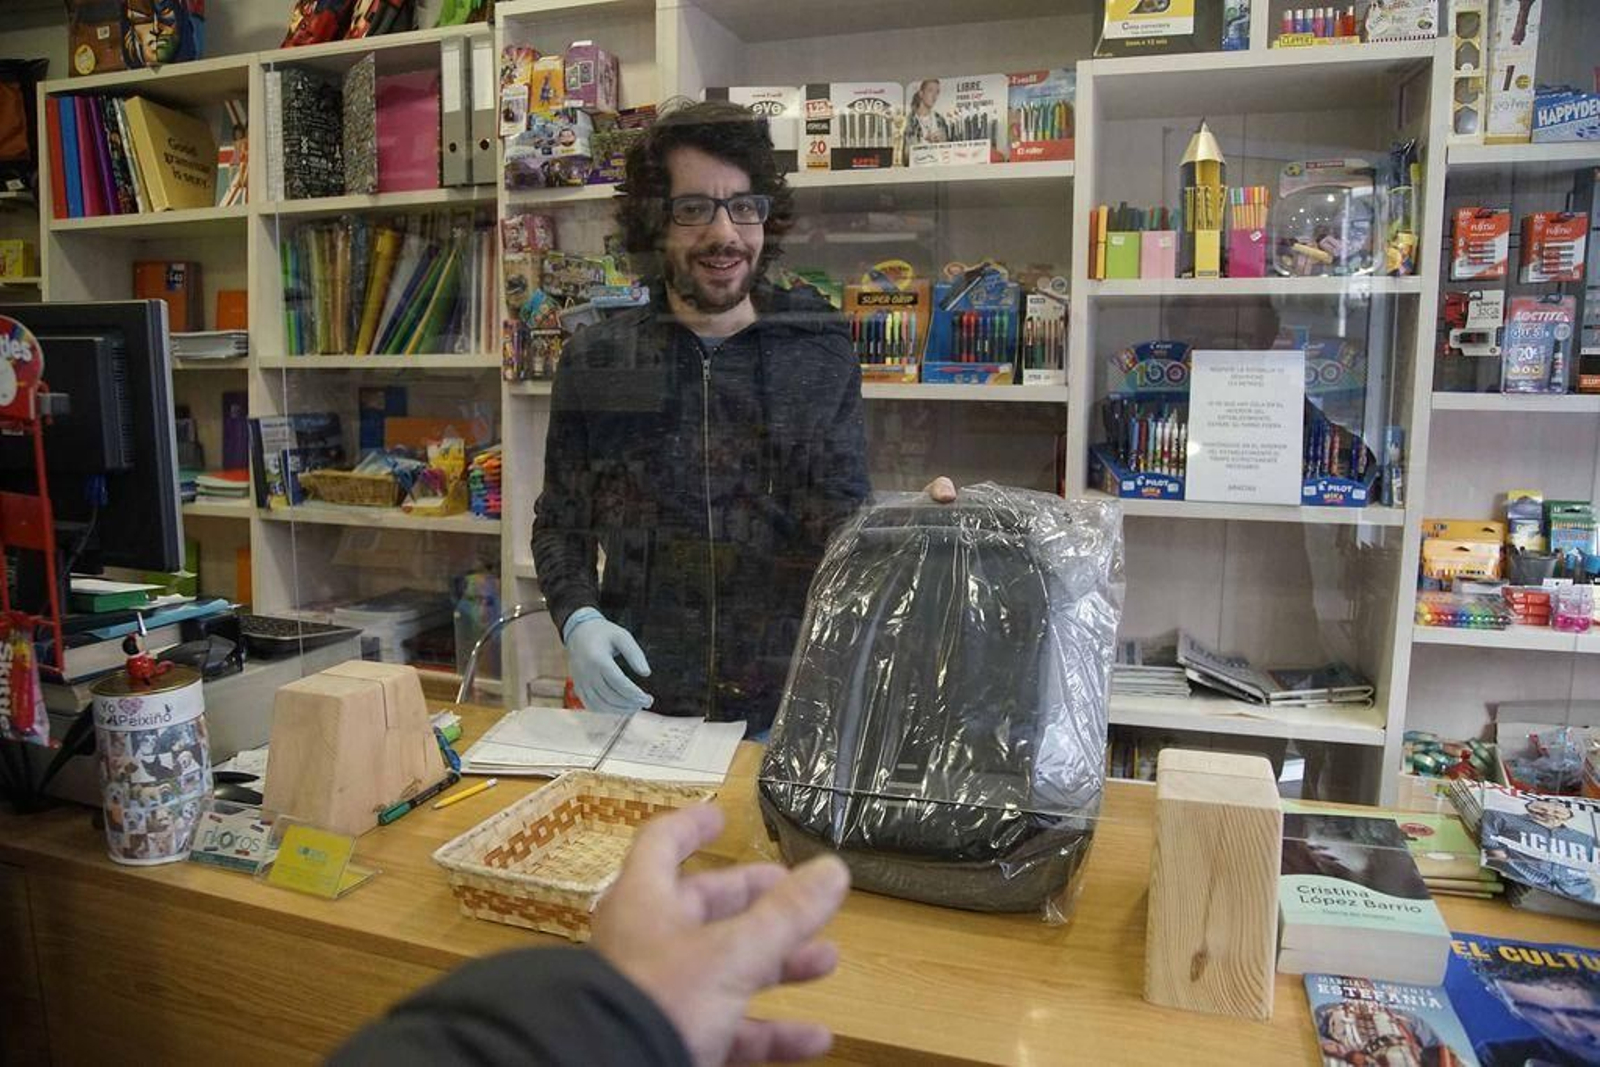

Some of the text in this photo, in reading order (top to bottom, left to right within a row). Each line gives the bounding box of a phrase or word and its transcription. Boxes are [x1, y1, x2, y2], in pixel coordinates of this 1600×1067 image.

[752, 101, 782, 116] eye
[854, 99, 884, 114] eye
[1537, 98, 1600, 127] HAPPYDE
[809, 140, 827, 155] 20
[1145, 479, 1169, 487] PILOT
[1327, 484, 1354, 493] PILOT
[101, 700, 116, 713] Yo
[1296, 884, 1371, 899] Cristina
[1299, 894, 1359, 907] López
[1363, 899, 1422, 914] Barrio
[1449, 939, 1600, 973] EL CULTU
